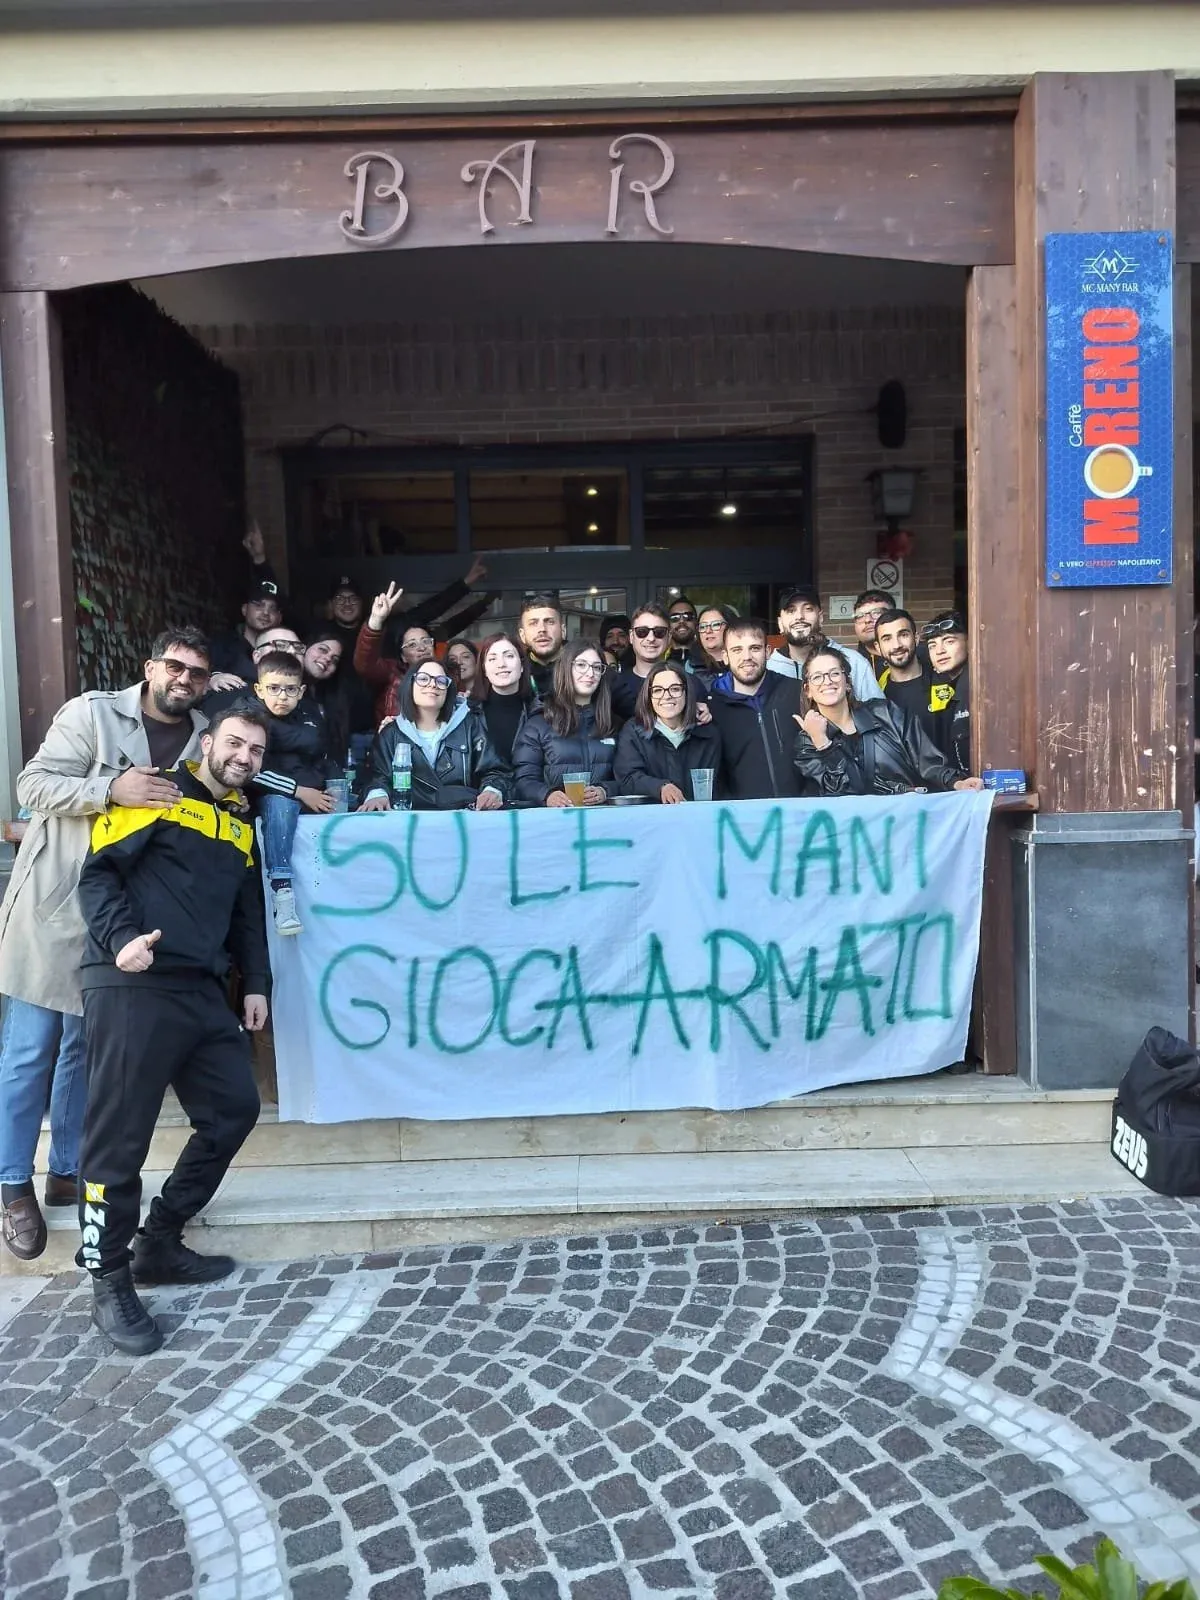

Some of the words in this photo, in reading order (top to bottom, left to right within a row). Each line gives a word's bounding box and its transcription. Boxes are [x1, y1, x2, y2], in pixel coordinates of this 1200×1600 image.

[338, 132, 675, 245] BAR
[1097, 282, 1121, 293] MANY
[1122, 282, 1139, 292] BAR
[1069, 404, 1082, 447] Caffè
[1066, 560, 1084, 568] VERO
[840, 603, 848, 614] 6
[180, 807, 206, 821] Zeus
[311, 811, 468, 916] SU
[510, 808, 640, 907] LE
[717, 806, 929, 899] MANI
[319, 943, 598, 1055] GIOCA
[630, 911, 955, 1058] ARMATO
[1113, 1115, 1148, 1179] ZEUS
